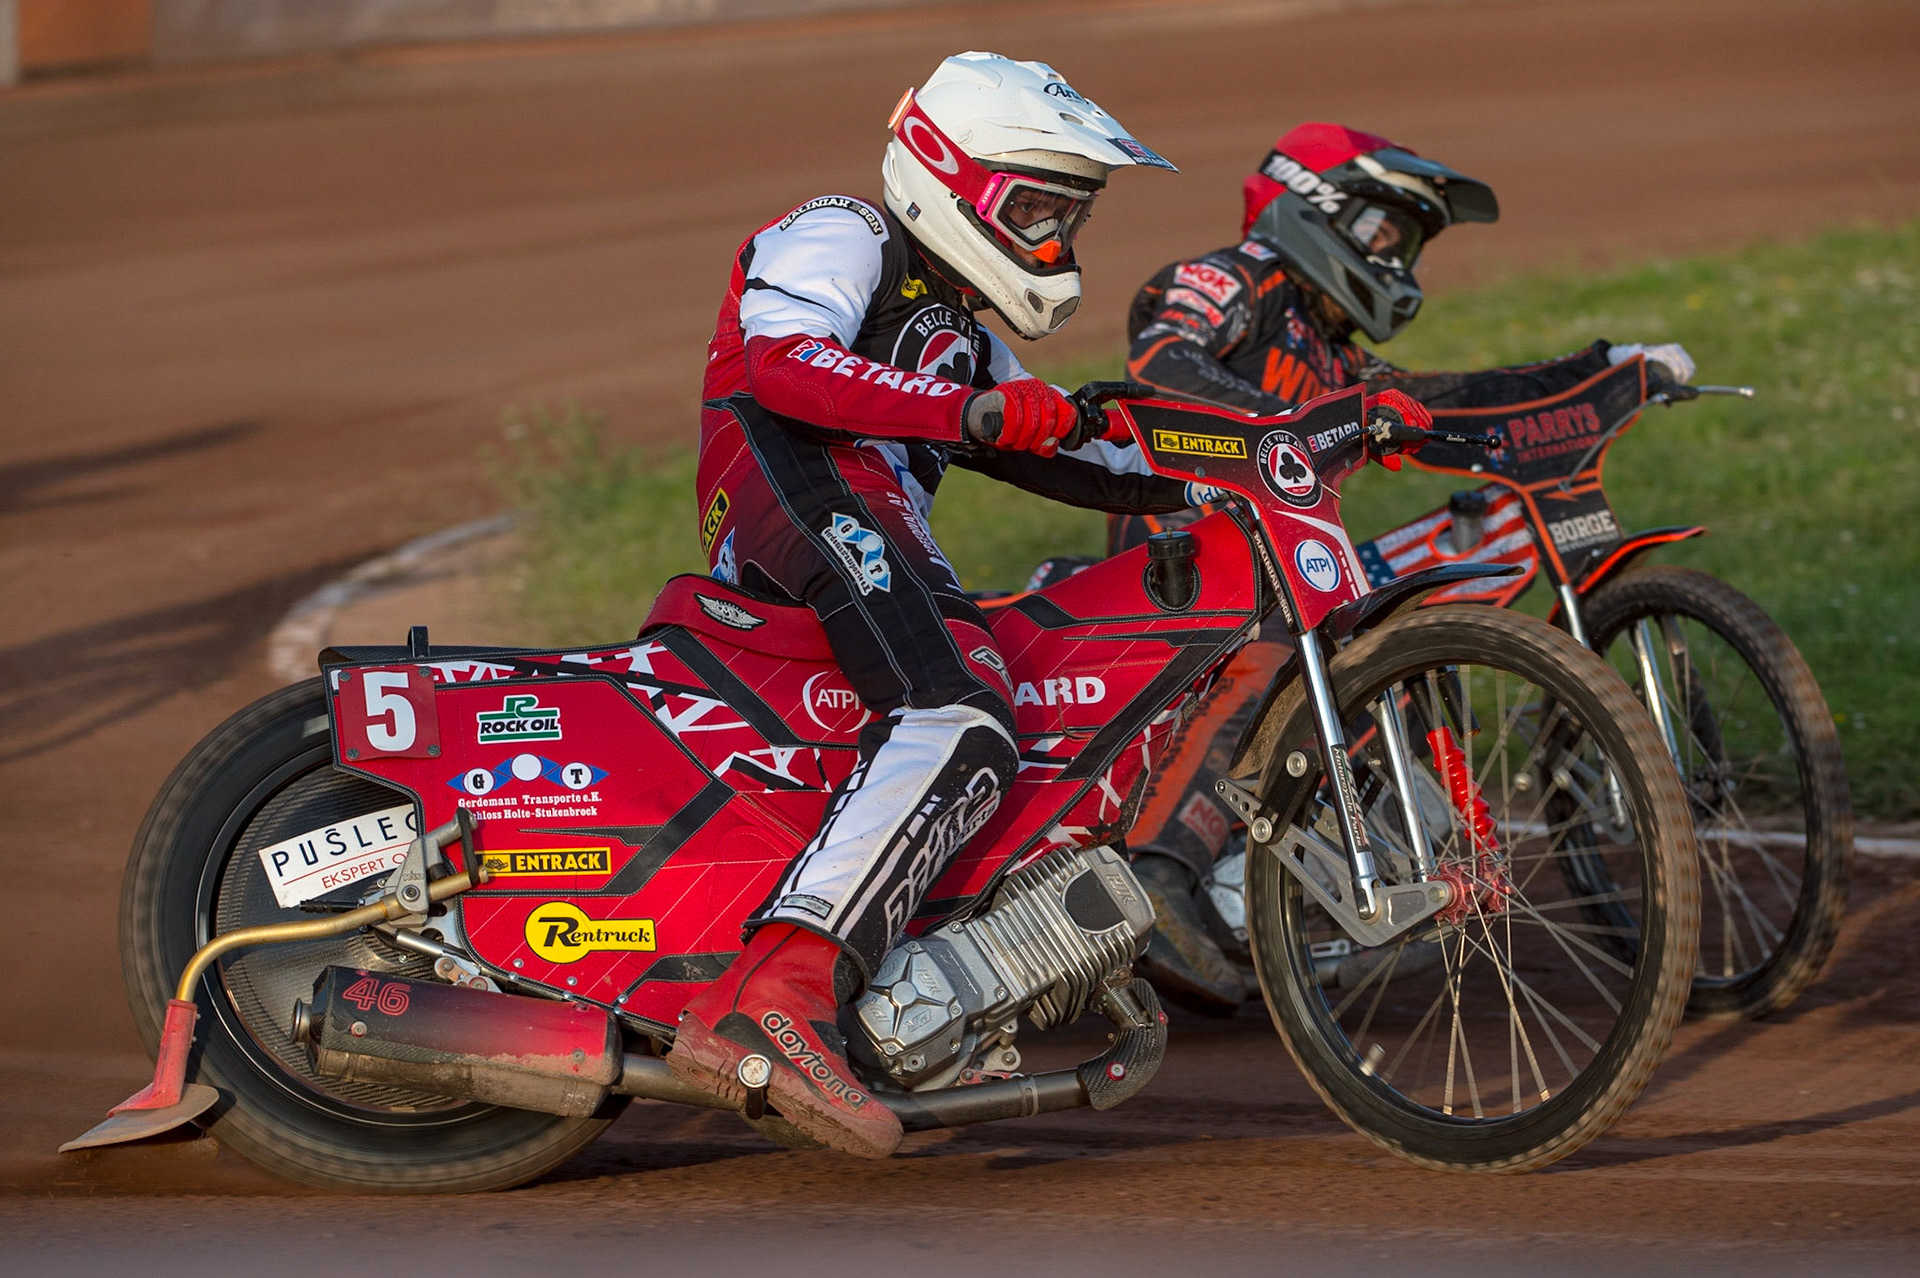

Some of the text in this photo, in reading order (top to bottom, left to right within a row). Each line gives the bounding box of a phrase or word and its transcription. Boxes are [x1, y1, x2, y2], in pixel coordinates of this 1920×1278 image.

[1263, 155, 1348, 214] 100%
[781, 198, 850, 230] MALINIAK
[914, 310, 953, 338] BELLE
[810, 347, 962, 397] BETARD
[1507, 402, 1601, 450] PARRYS
[1181, 436, 1240, 455] ENTRACK
[1259, 438, 1274, 465] BELLE
[1273, 434, 1290, 443] VUE
[841, 523, 853, 534] G
[1547, 509, 1617, 544] BORGE
[869, 564, 883, 575] T
[1306, 557, 1332, 573] ATPI
[362, 670, 417, 752] 5
[815, 688, 860, 711] ATPI
[480, 718, 560, 735] ROCK OIL
[472, 773, 485, 790] G
[570, 768, 584, 785] T
[1333, 747, 1353, 811] Motorcycle
[457, 791, 603, 808] Gerdemann Transporte e.K.
[503, 806, 598, 820] Holte-Stukenbrock
[321, 857, 385, 889] EKSPERT
[516, 852, 601, 871] ENTRACK
[538, 916, 651, 948] Rentruck
[342, 977, 413, 1017] 46
[761, 1010, 870, 1111] daytona
